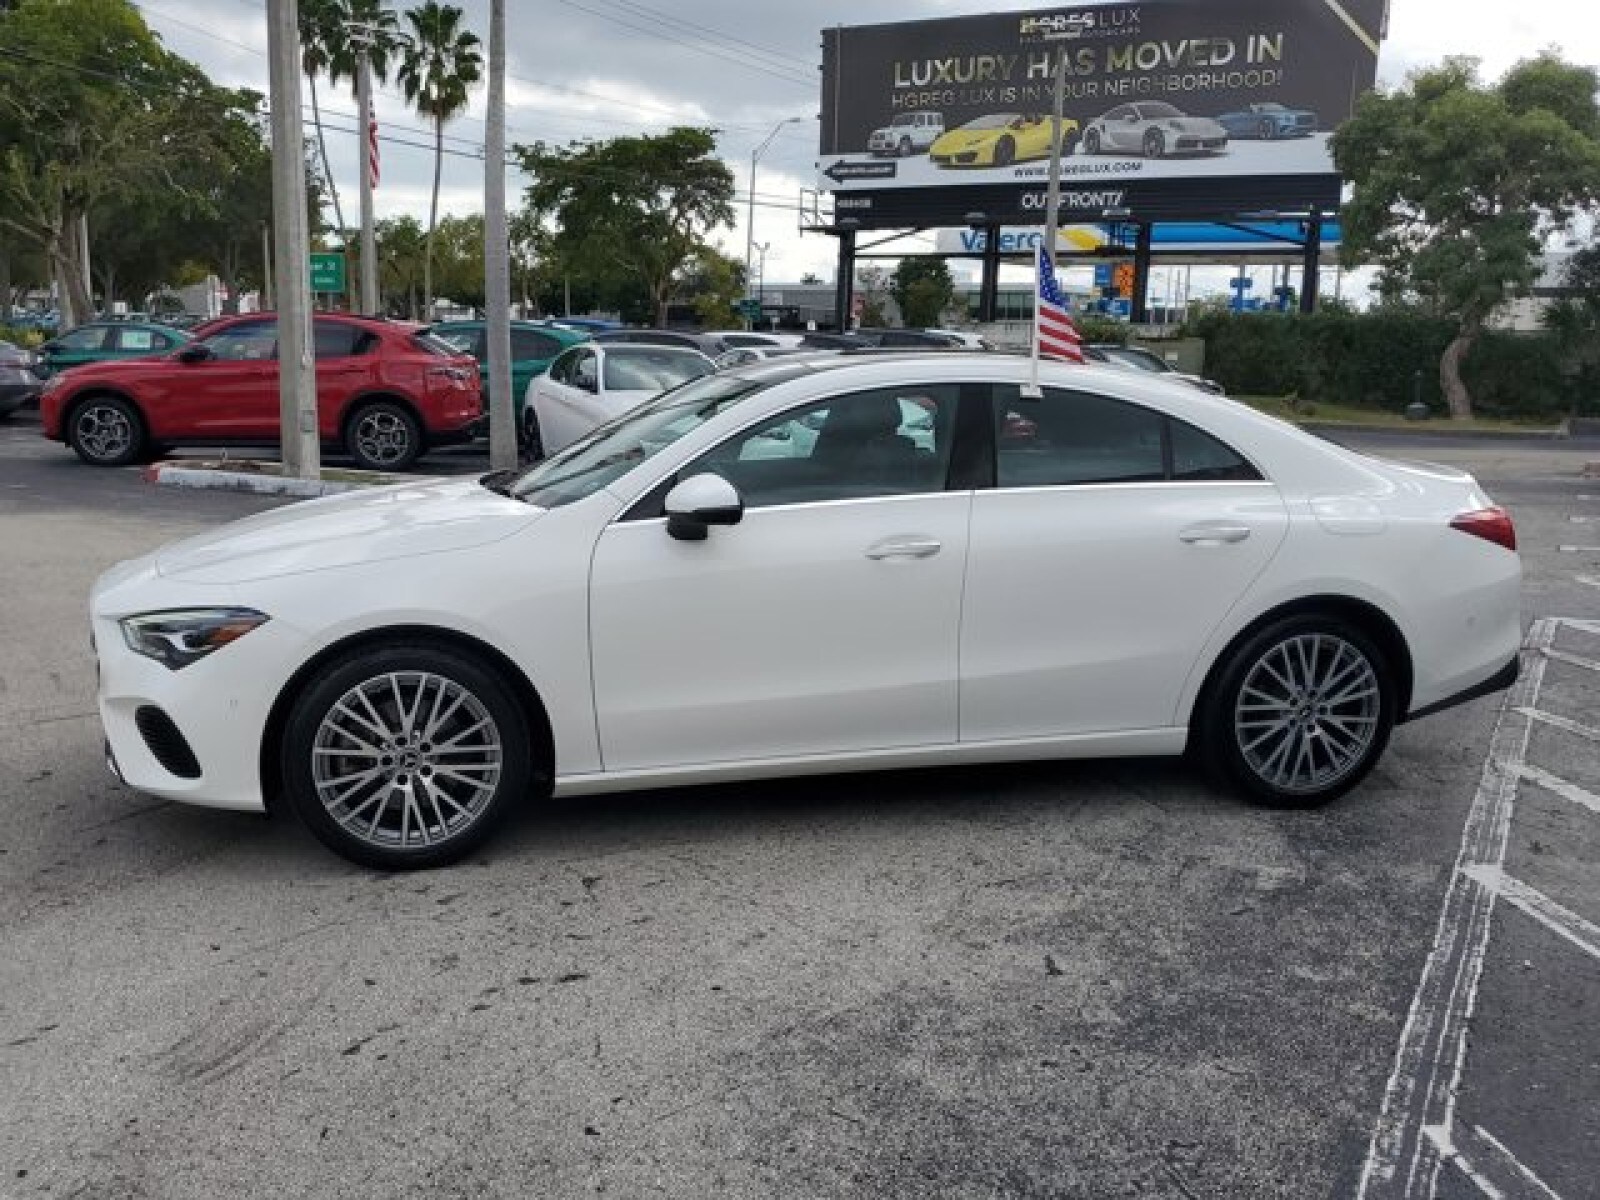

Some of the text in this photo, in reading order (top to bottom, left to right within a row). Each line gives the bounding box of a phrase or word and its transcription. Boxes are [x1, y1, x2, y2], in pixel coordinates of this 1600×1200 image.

[894, 32, 1284, 88] LUXURY HAS MOVED IN
[892, 89, 954, 109] HGREG
[1000, 87, 1016, 103] IS
[1022, 84, 1041, 101] IN
[1104, 69, 1283, 96] NEIGHBORHOOD!
[959, 229, 1043, 251] Vaero
